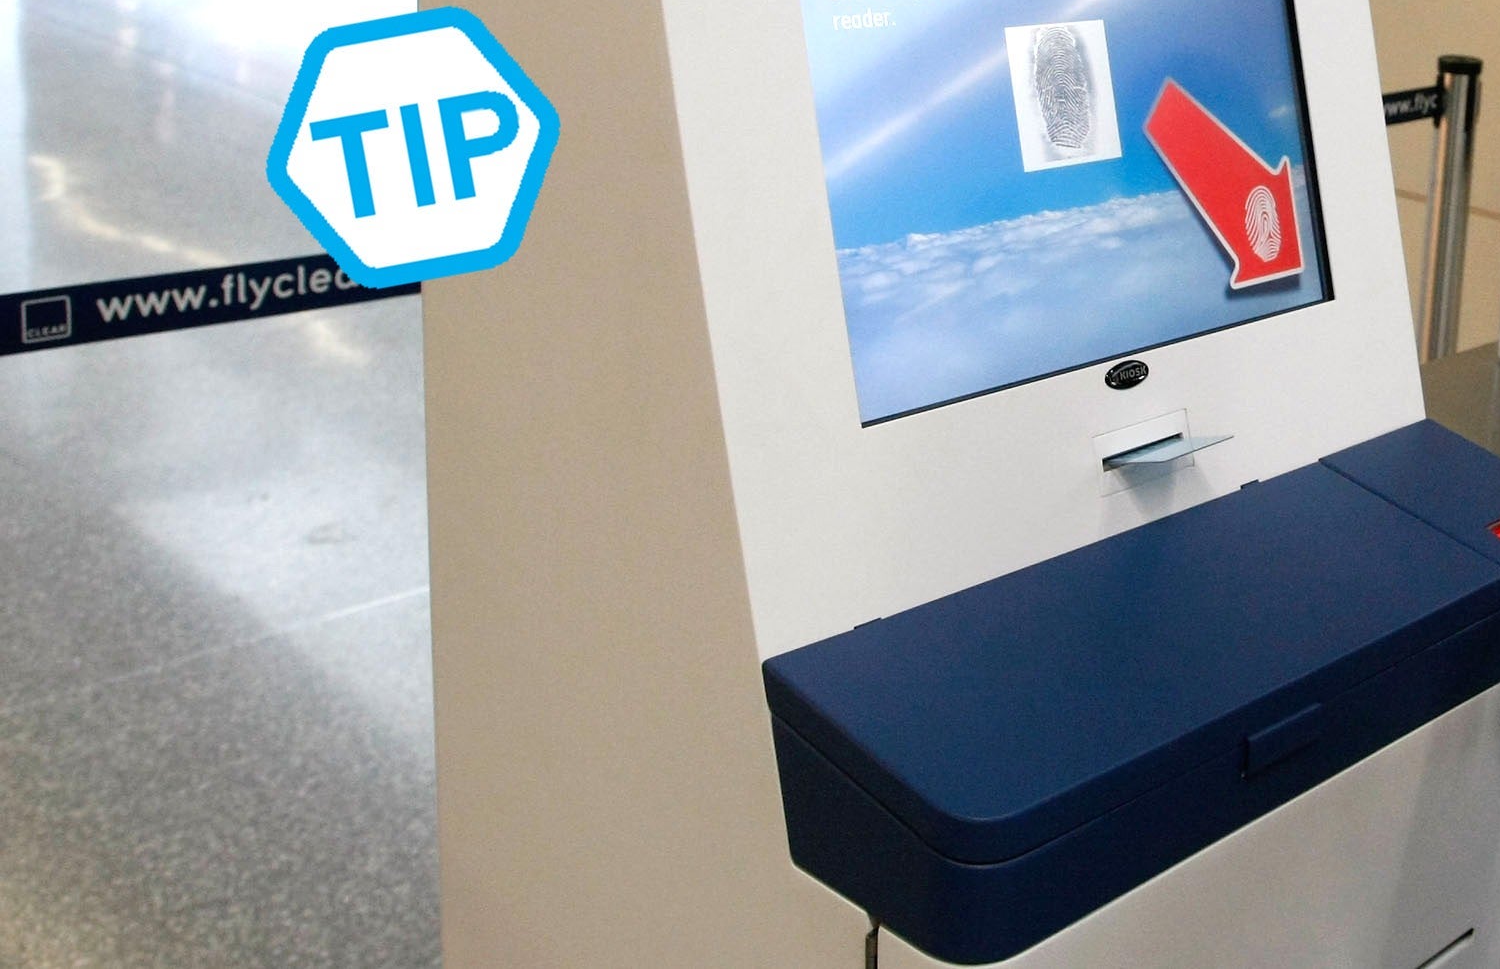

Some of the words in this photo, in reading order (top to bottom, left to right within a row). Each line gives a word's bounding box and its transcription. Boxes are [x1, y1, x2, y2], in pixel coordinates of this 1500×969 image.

[832, 7, 897, 31] reader.
[1384, 92, 1438, 116] ww.flyc
[1120, 365, 1147, 380] KIOSK
